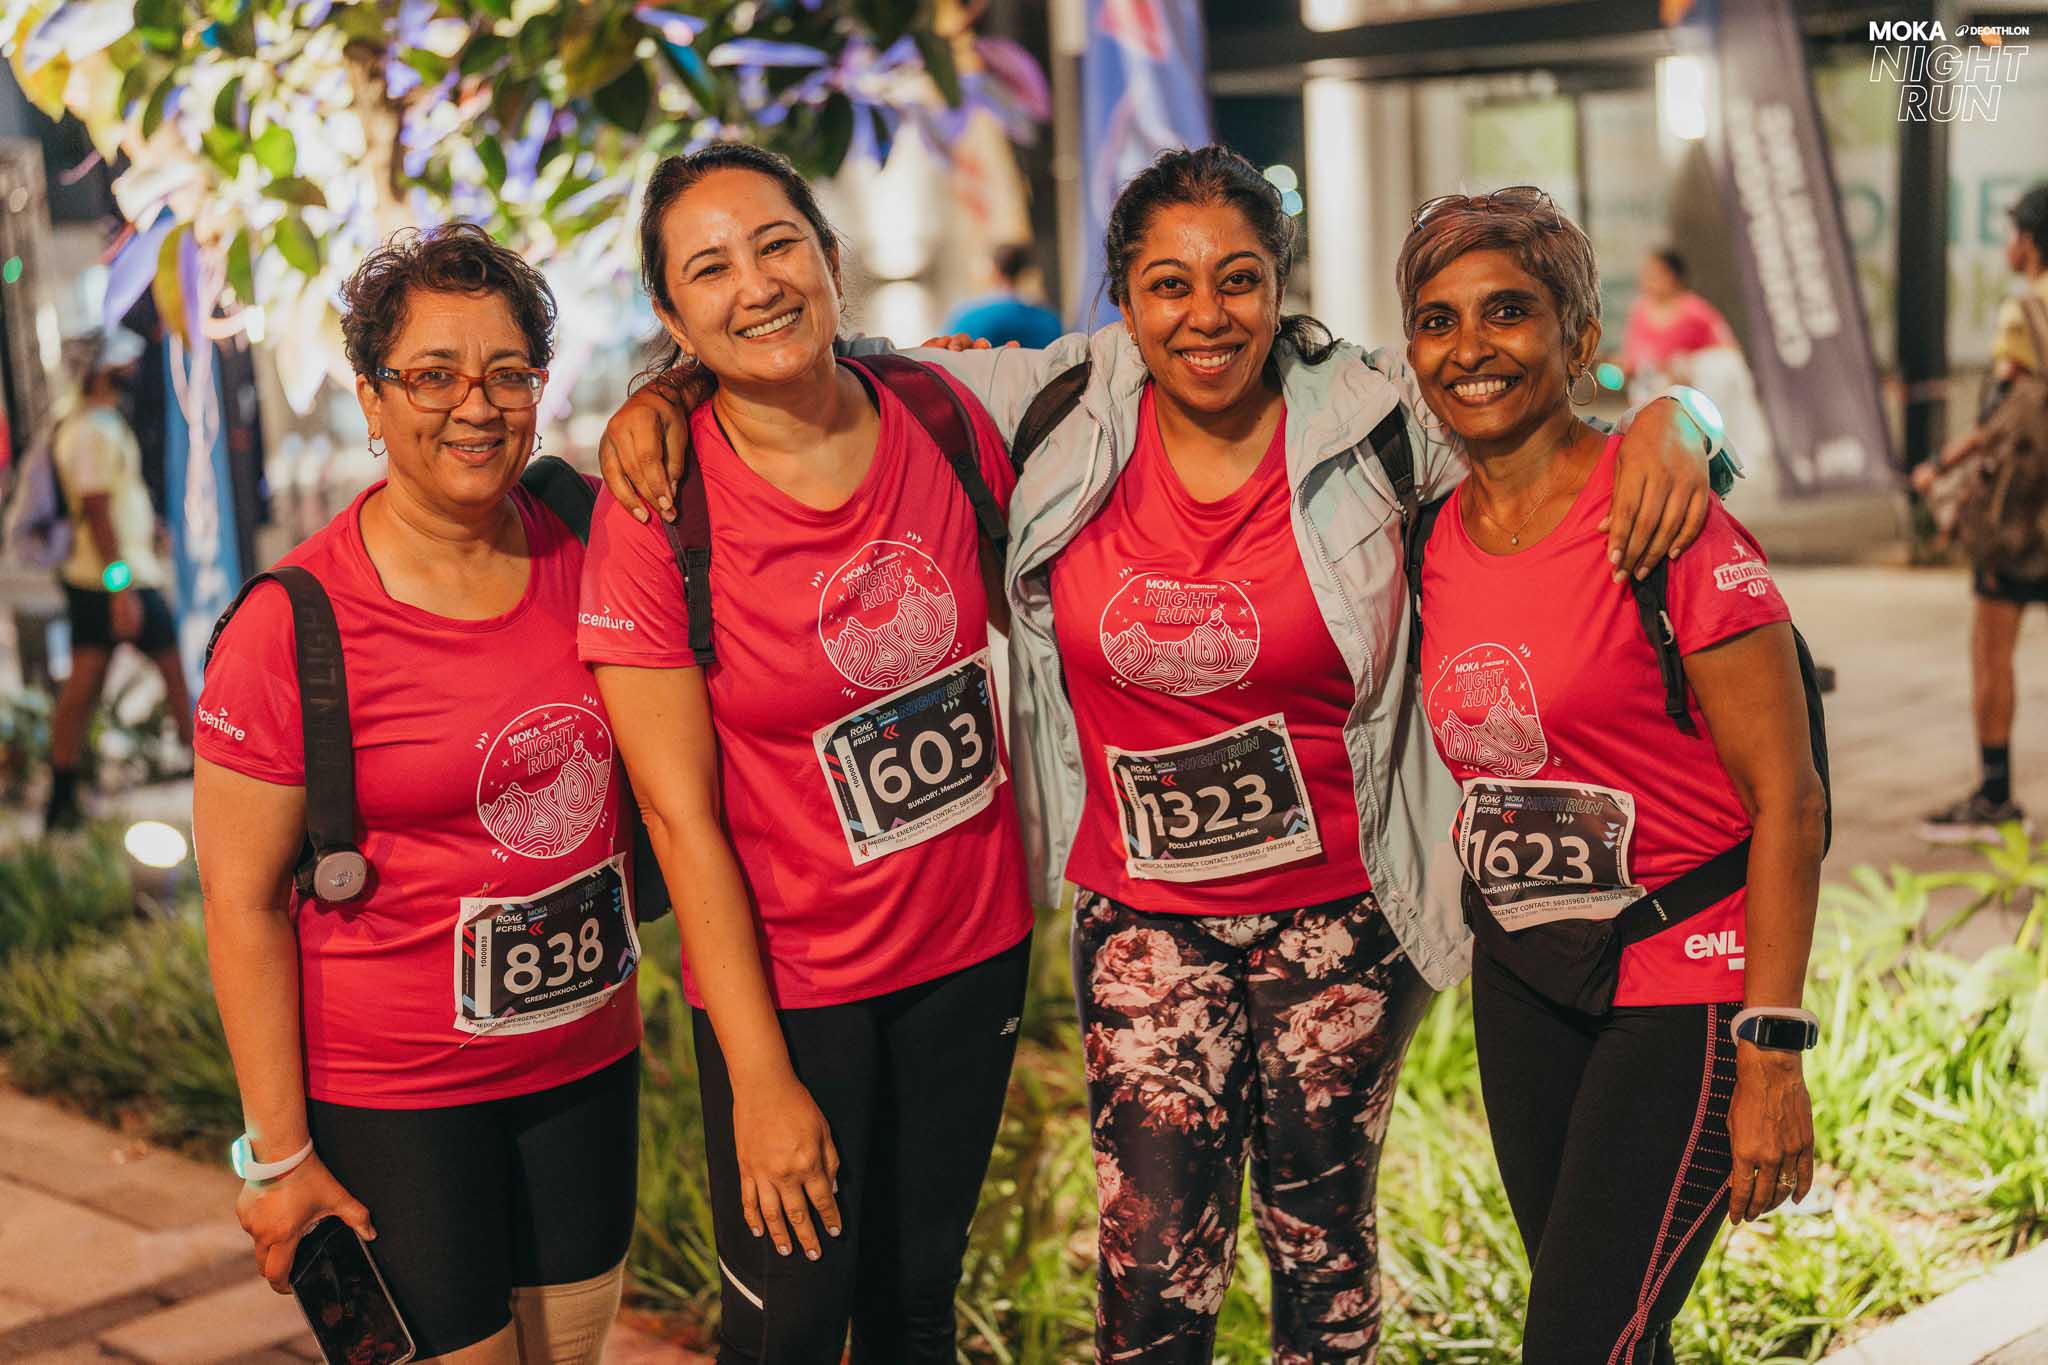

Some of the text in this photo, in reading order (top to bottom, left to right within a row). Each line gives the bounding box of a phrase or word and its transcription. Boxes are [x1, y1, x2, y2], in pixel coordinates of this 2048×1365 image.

[842, 563, 872, 583] MOKA
[847, 560, 902, 599] NIGHT
[1145, 579, 1180, 590] MOKA
[860, 581, 902, 611] RUN
[1144, 589, 1216, 609] NIGHT
[578, 612, 635, 632] centure
[1155, 607, 1204, 624] RUN
[1455, 661, 1479, 673] MOKA
[1455, 668, 1504, 692] NIGHT
[1461, 686, 1497, 708] RUN
[198, 703, 245, 741] centure
[508, 727, 541, 746] MOKA
[512, 723, 575, 764] NIGHT
[528, 744, 569, 776] RUN
[869, 712, 983, 804] 603
[1141, 774, 1273, 839] 1323
[1469, 829, 1594, 884] 1623
[496, 914, 523, 923] ROAG
[503, 917, 604, 995] 838
[524, 992, 549, 1004] GREEN
